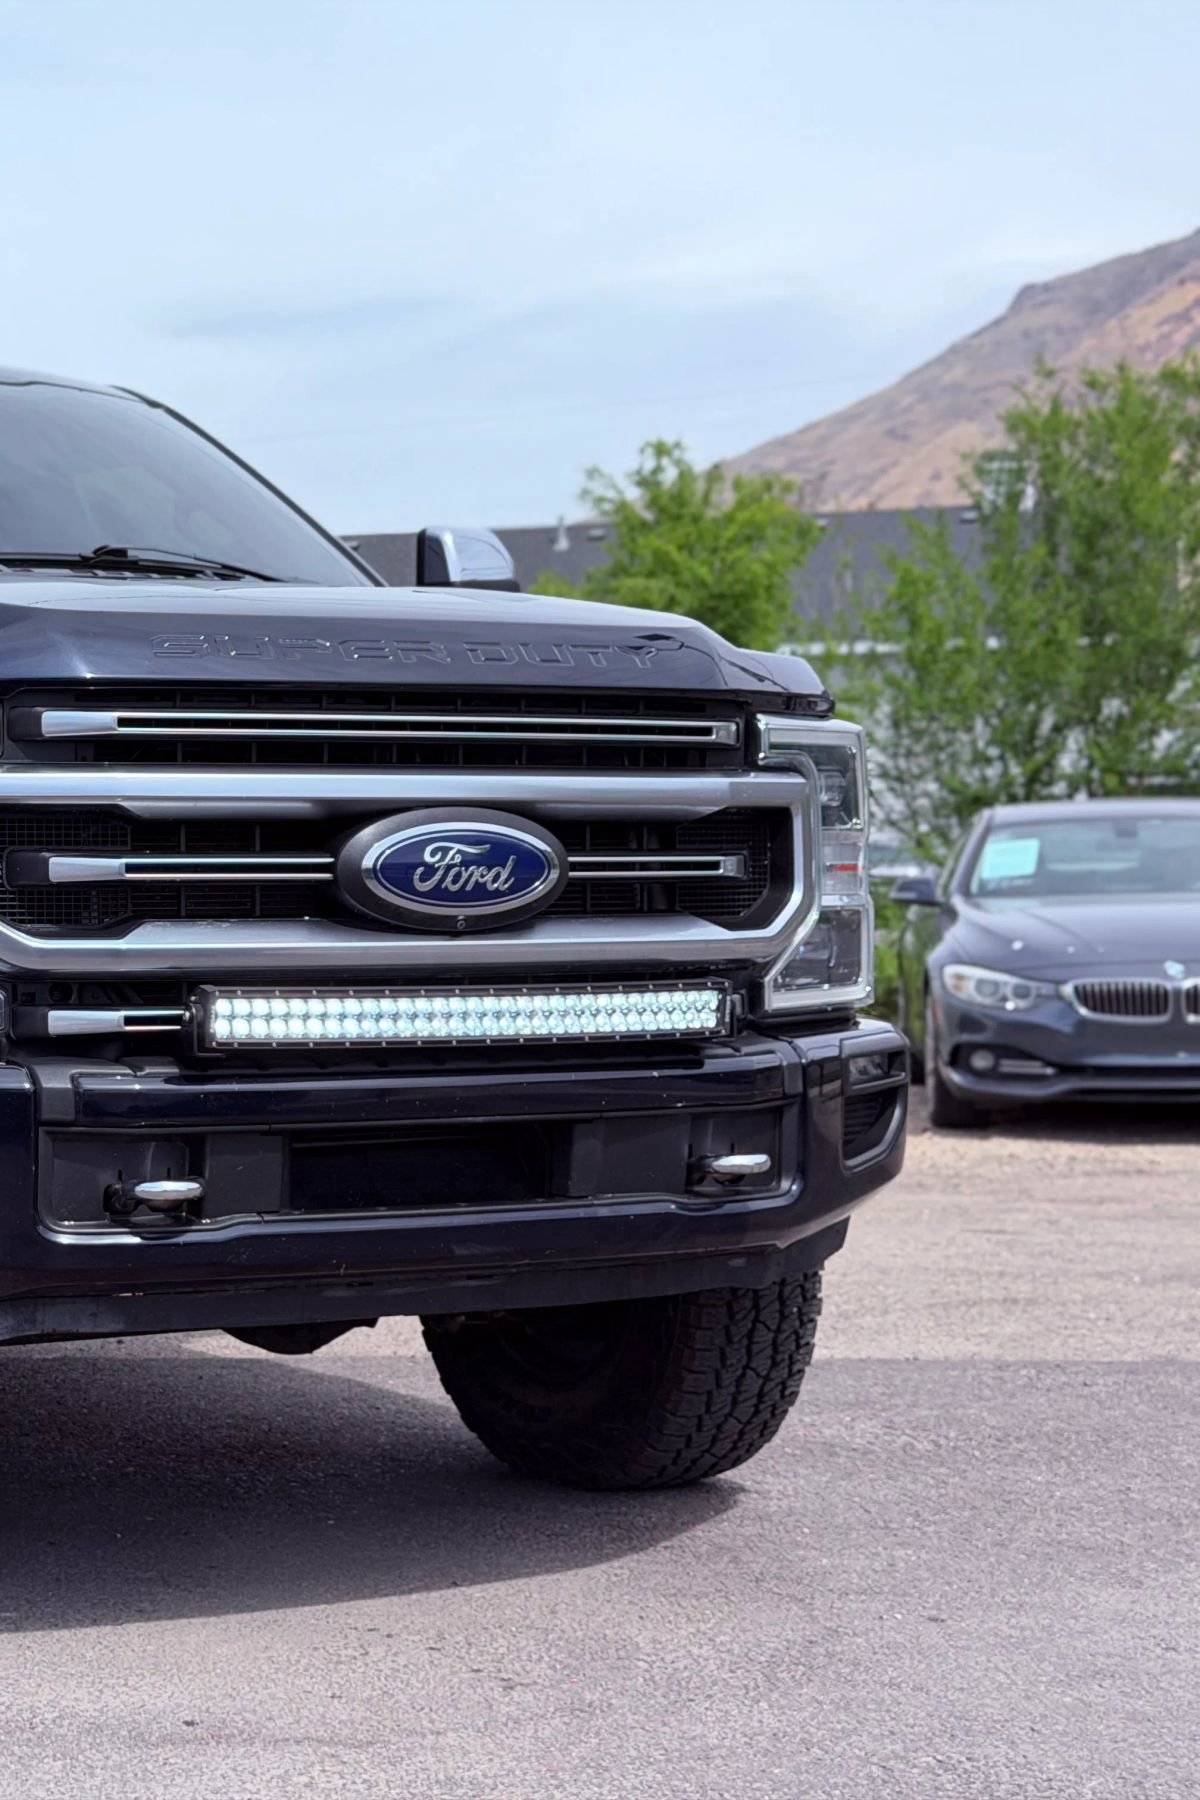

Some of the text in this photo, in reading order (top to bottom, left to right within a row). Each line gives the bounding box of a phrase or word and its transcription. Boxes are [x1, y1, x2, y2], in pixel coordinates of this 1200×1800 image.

[150, 633, 659, 669] SUPER DUTY
[412, 841, 517, 893] Ford
